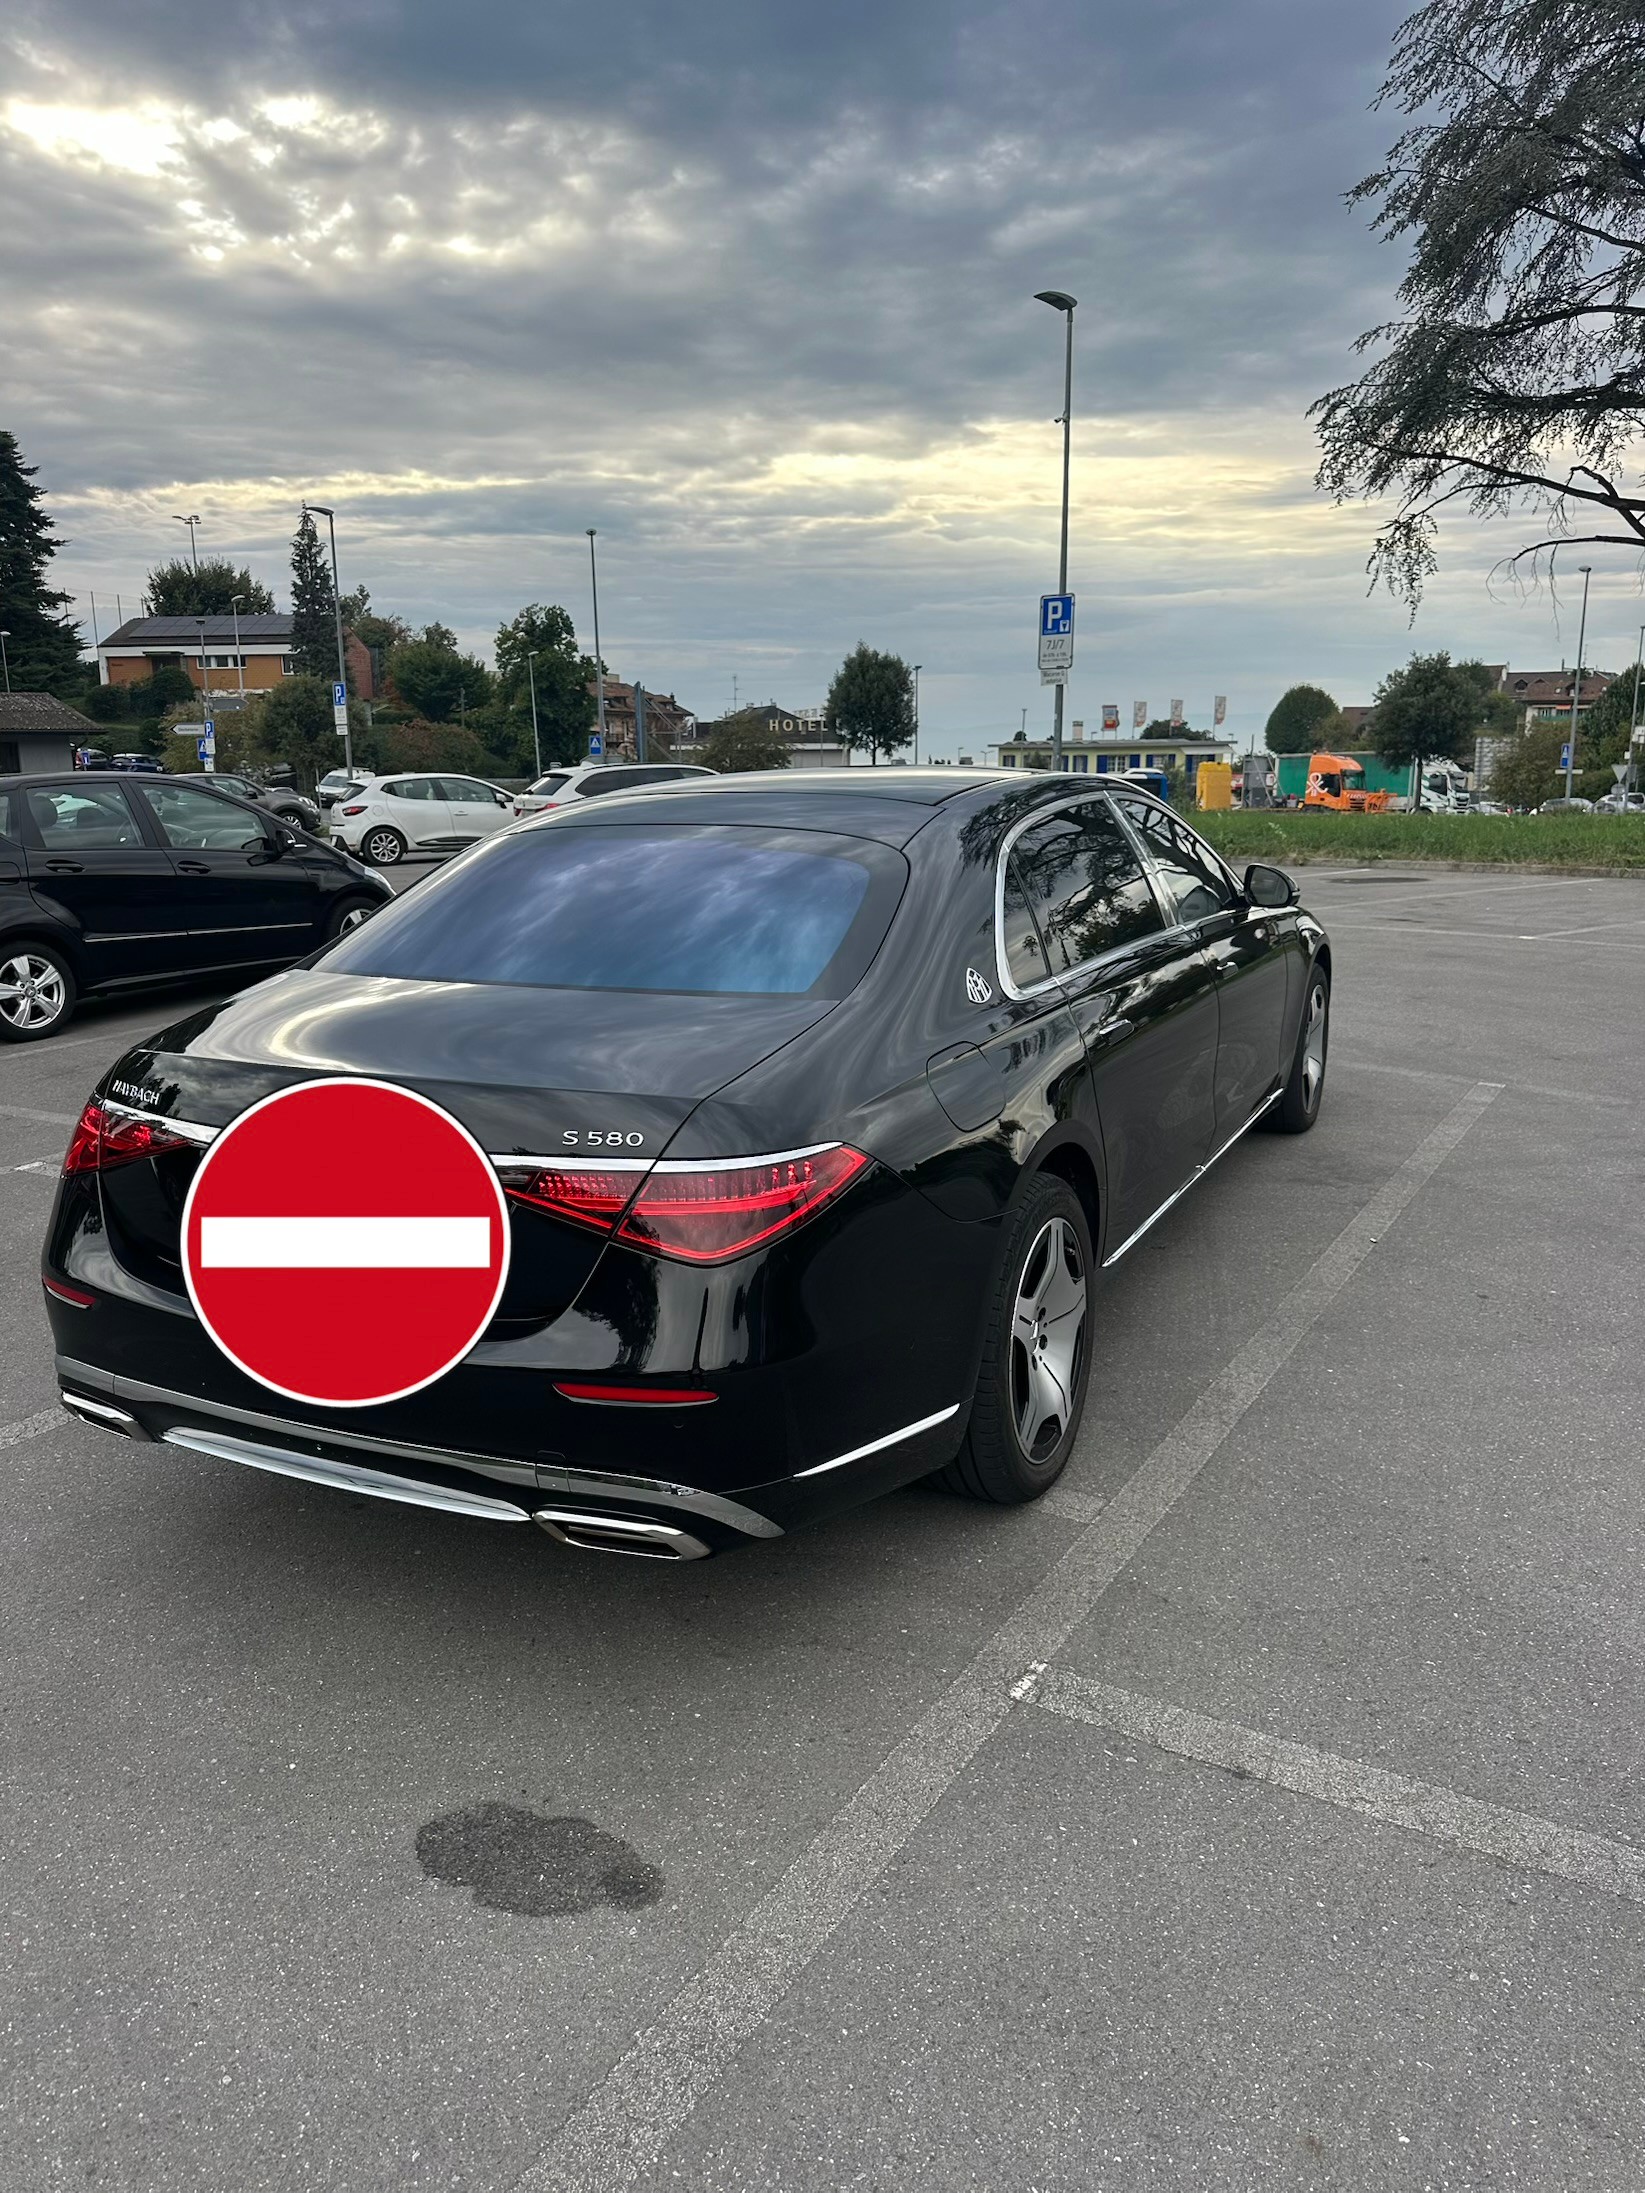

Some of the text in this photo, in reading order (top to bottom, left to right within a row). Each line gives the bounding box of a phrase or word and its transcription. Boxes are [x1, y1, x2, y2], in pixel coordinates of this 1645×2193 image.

[1047, 600, 1062, 629] P
[335, 685, 342, 703] P
[205, 722, 212, 737] P
[769, 719, 829, 732] HOTEL
[562, 1130, 644, 1147] S 580
